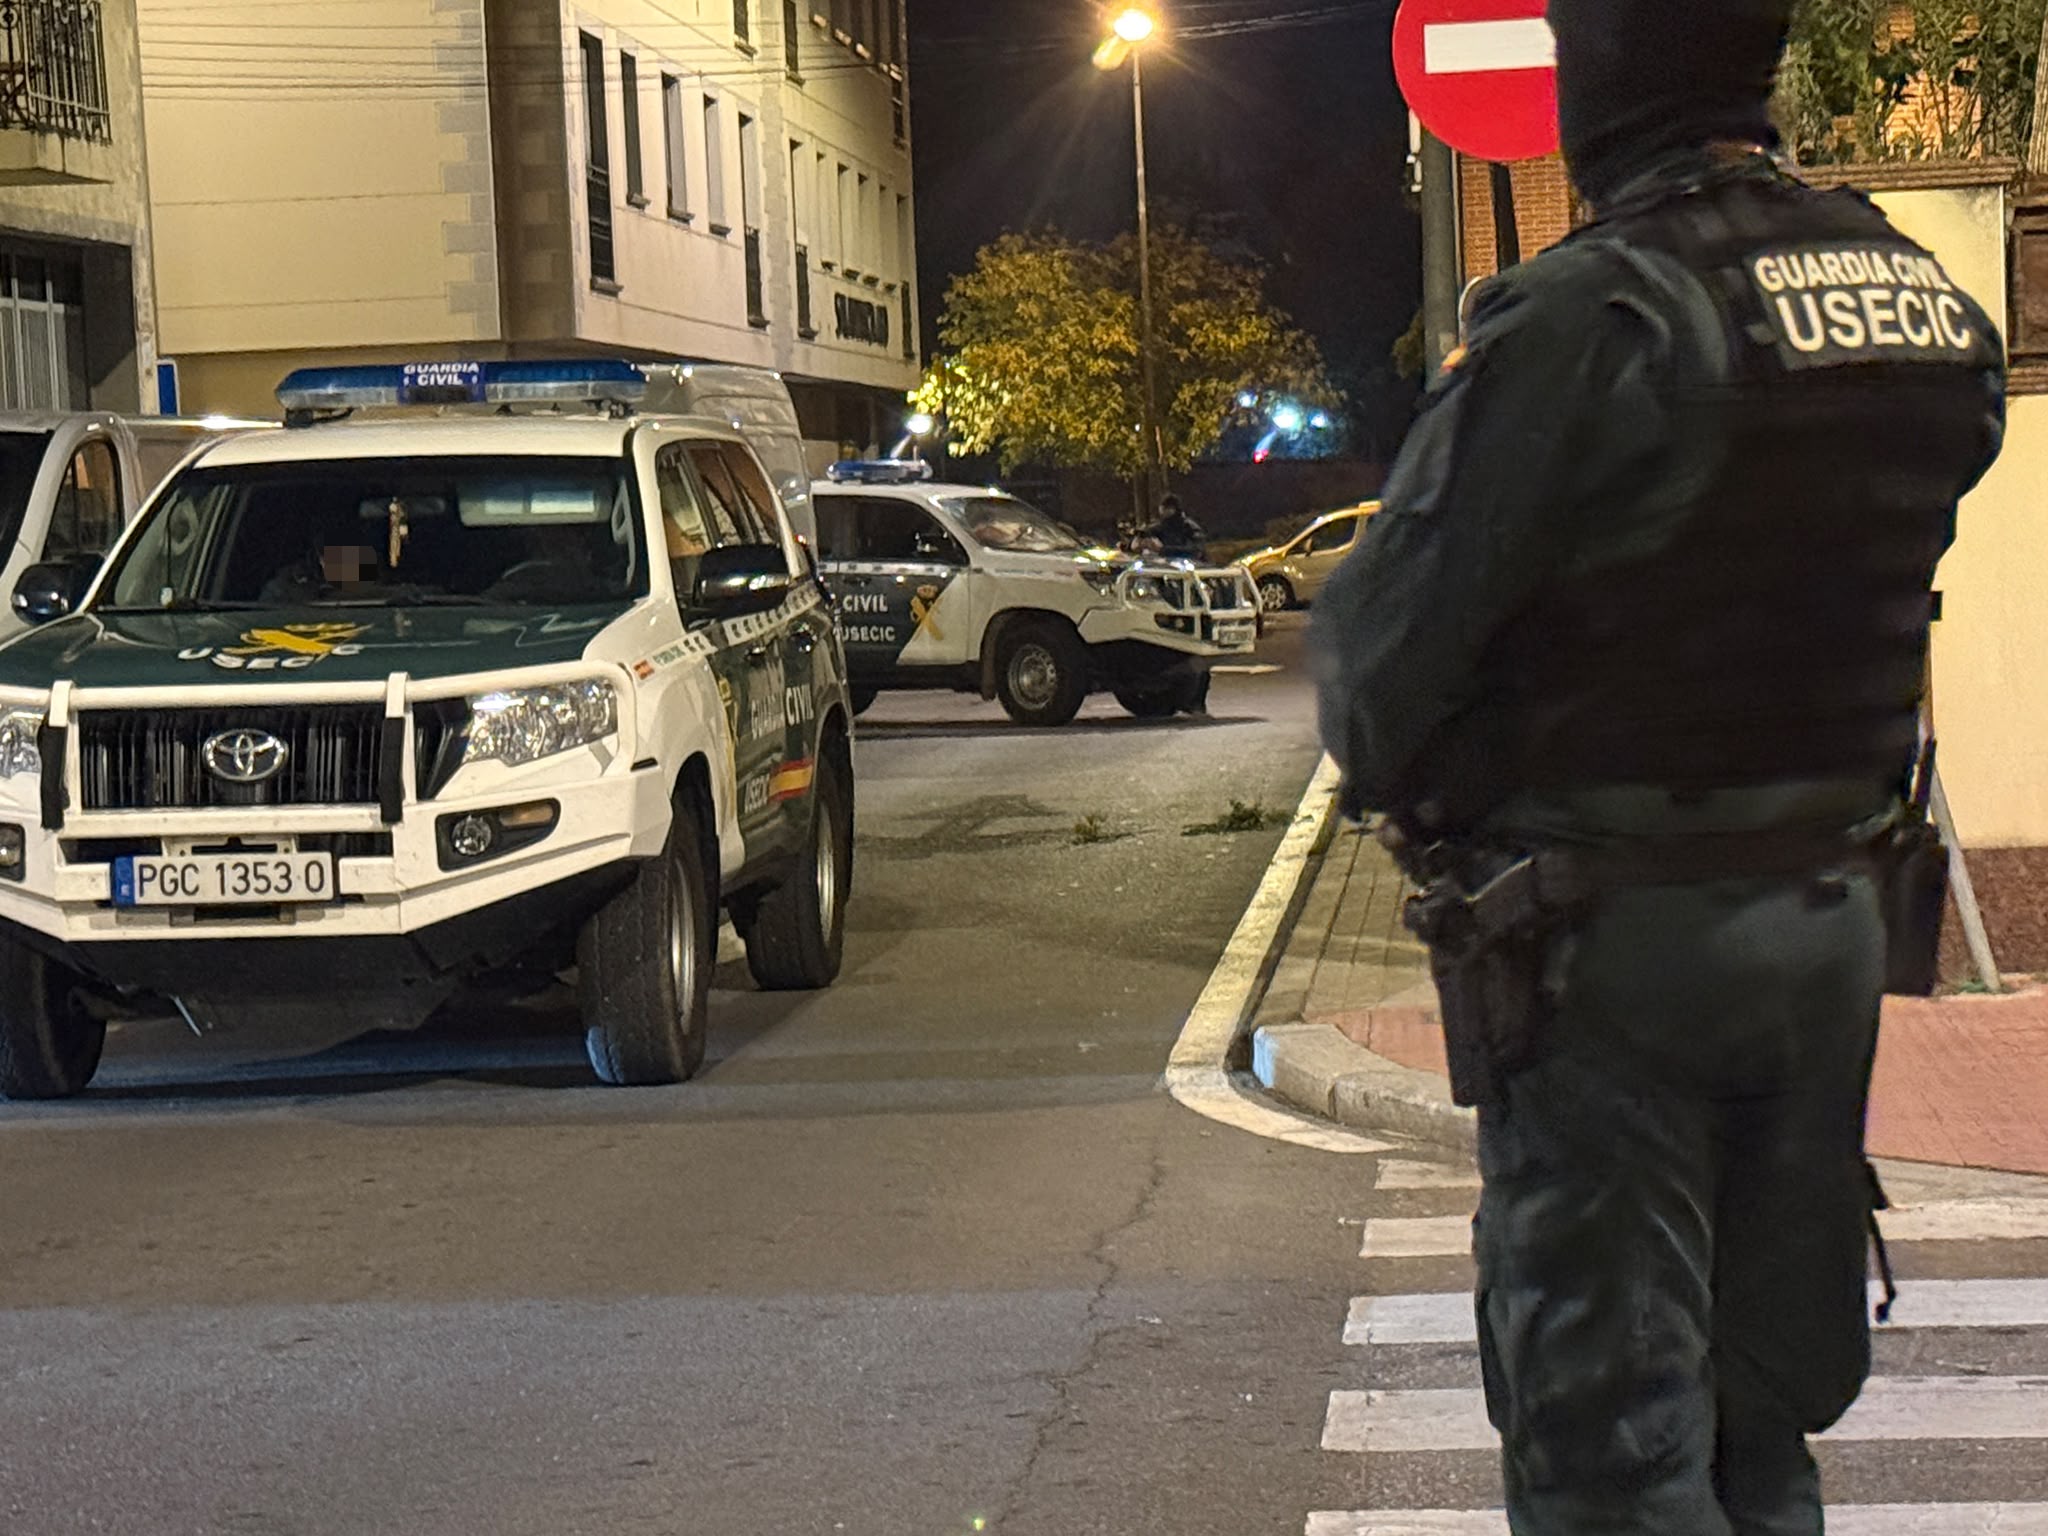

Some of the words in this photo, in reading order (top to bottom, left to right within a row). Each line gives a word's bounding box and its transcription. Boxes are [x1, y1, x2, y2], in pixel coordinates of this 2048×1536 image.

[1754, 251, 1897, 293] GUARDIA
[1891, 252, 1953, 292] CIVIL
[1775, 288, 1971, 352] USECIC
[403, 362, 480, 375] GUARDIA
[417, 374, 464, 387] CIVIL
[842, 594, 889, 613] CIVIL
[785, 683, 815, 727] CIVIL
[138, 862, 200, 897] PGC
[215, 861, 293, 897] 1353
